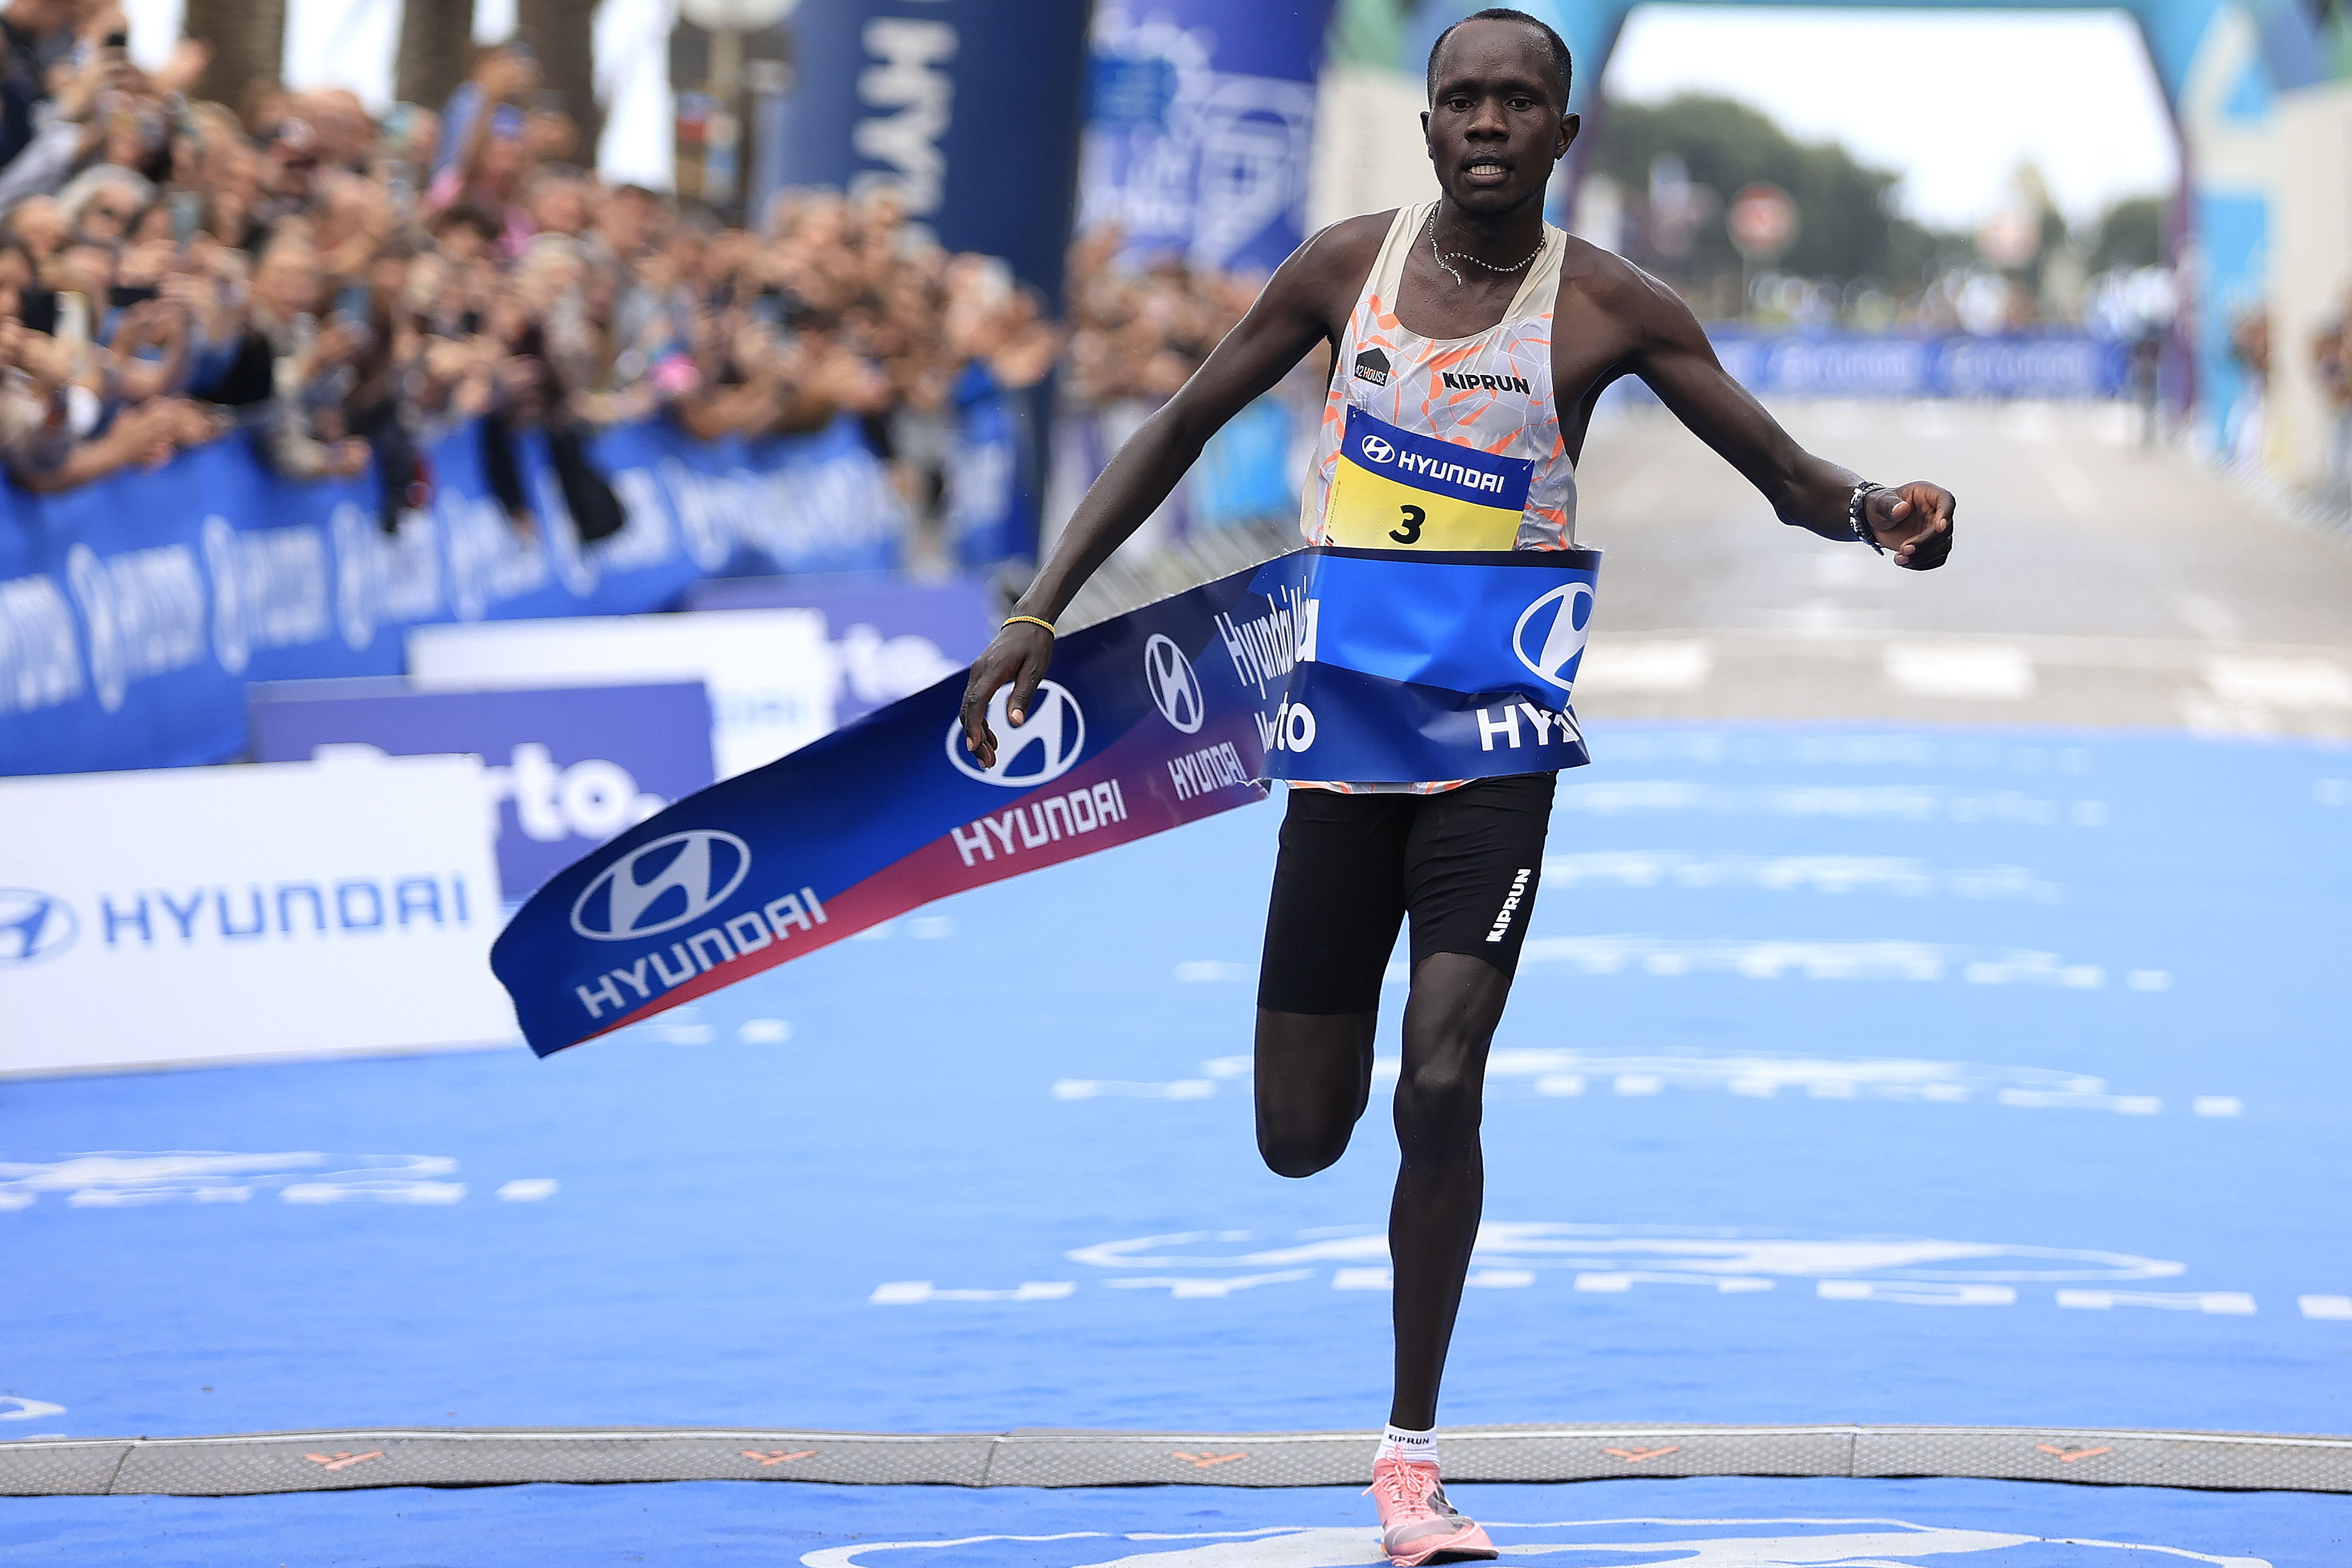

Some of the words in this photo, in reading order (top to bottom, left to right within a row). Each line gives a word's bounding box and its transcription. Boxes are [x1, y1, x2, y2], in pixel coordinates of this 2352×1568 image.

[1443, 372, 1530, 395] KIPRUN
[1398, 450, 1505, 493] HYUNDAI
[1388, 504, 1426, 545] 3
[1213, 584, 1294, 700] Hyundai
[1166, 740, 1248, 802] HYUNDAI
[950, 778, 1129, 867] HYUNDAI
[101, 871, 470, 944] HYUNDAI
[1485, 868, 1531, 942] KIPRUN
[574, 886, 828, 1019] HYUNDAI
[1388, 1433, 1430, 1445] KIPRUN
